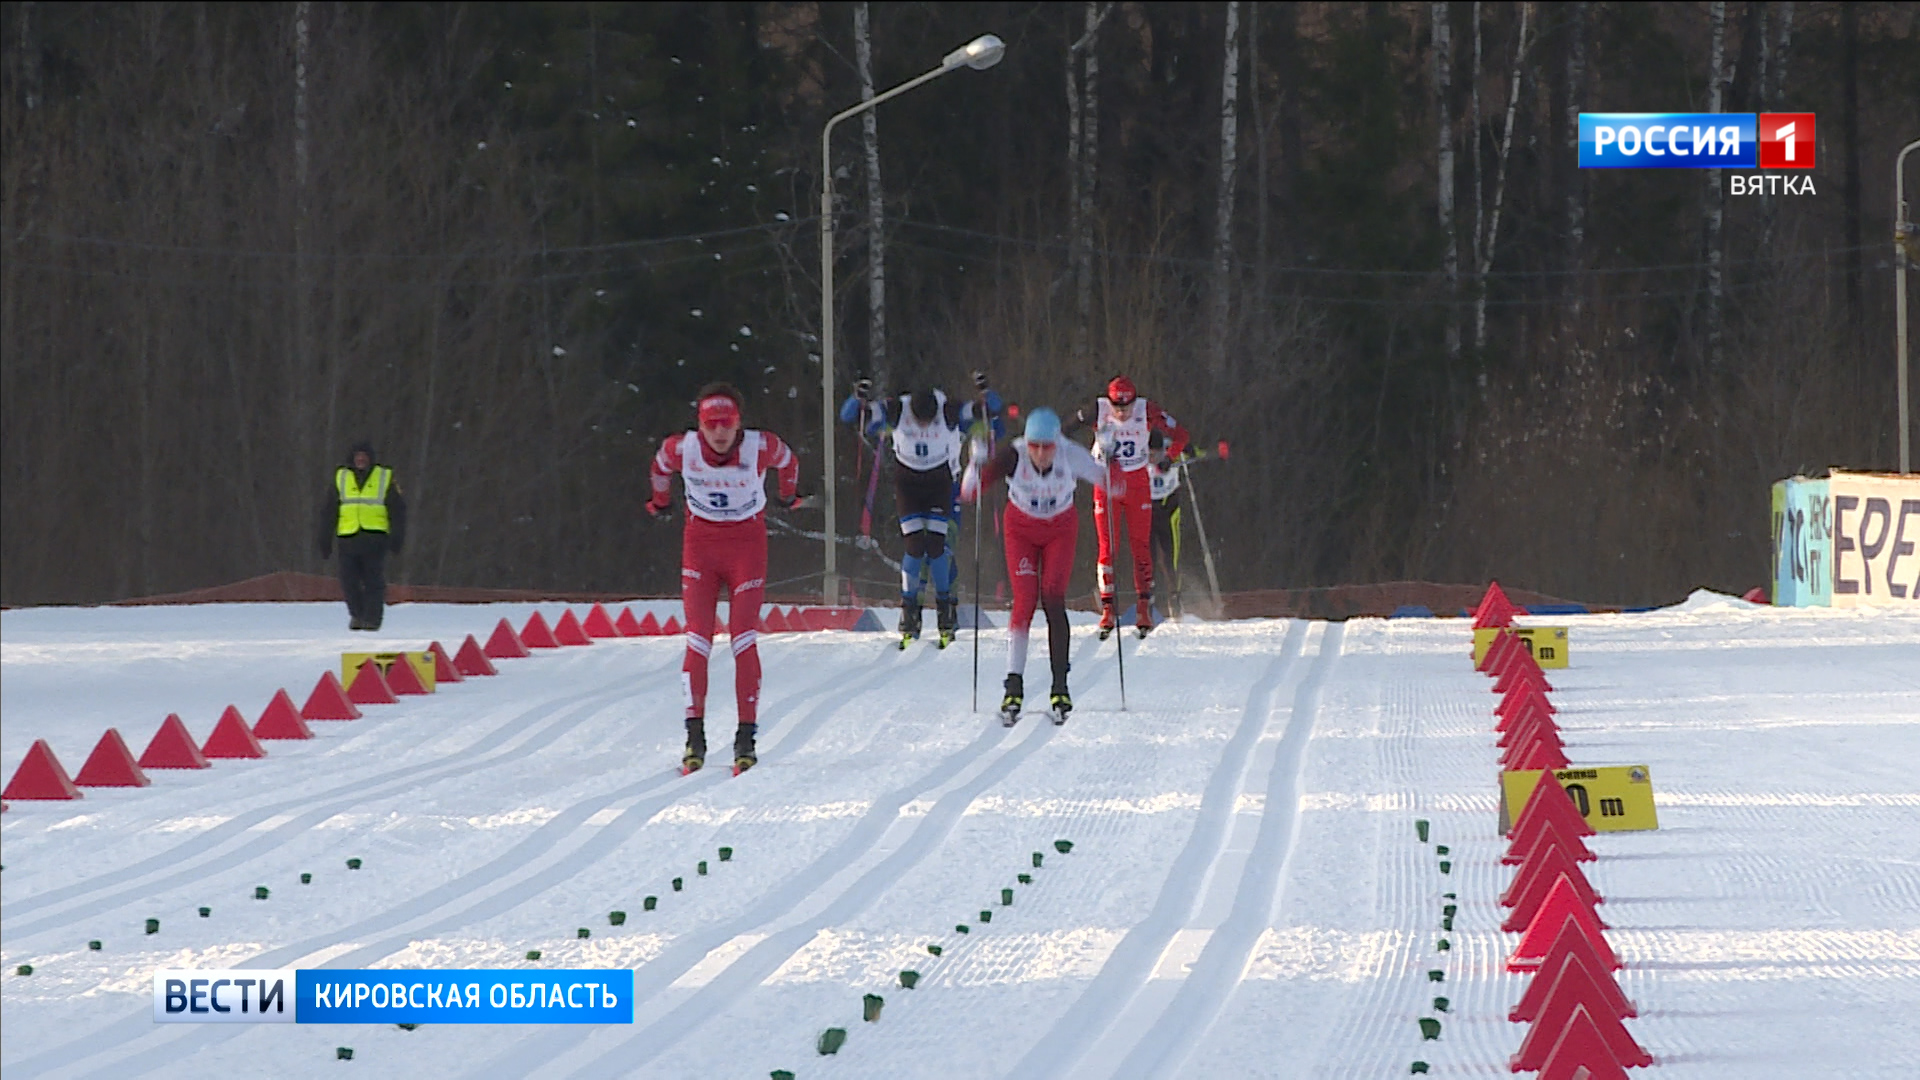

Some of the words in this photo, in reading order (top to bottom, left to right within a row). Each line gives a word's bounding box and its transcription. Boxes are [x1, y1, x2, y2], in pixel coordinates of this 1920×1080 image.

[707, 491, 729, 508] 3
[1834, 495, 1920, 600] ЕРЕ
[1600, 797, 1625, 816] m
